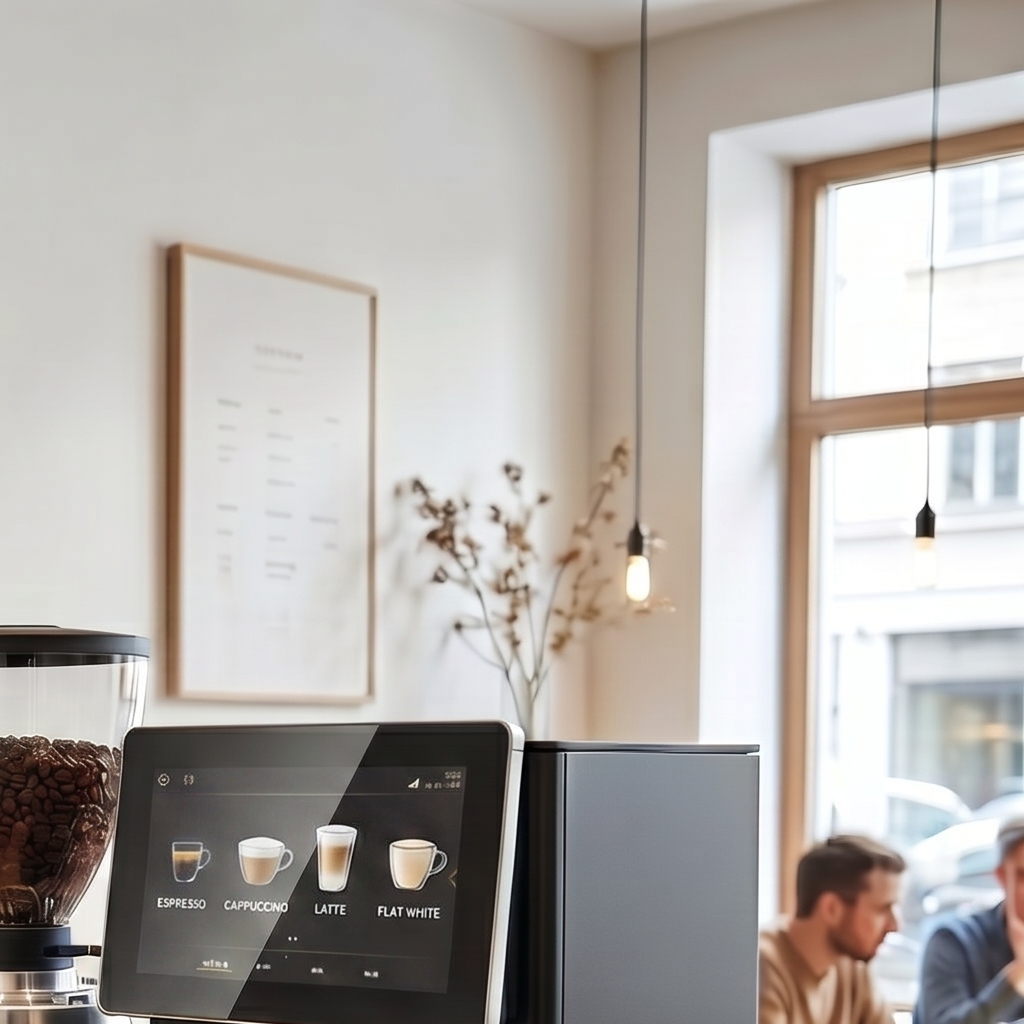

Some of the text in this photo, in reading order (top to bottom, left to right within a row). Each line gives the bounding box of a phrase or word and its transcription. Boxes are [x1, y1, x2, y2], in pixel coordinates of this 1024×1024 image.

[157, 897, 206, 910] ESPRESSO
[224, 900, 289, 913] CAPPUCCINO
[314, 903, 347, 915] LATTE
[377, 906, 441, 919] FLAT WHITE
